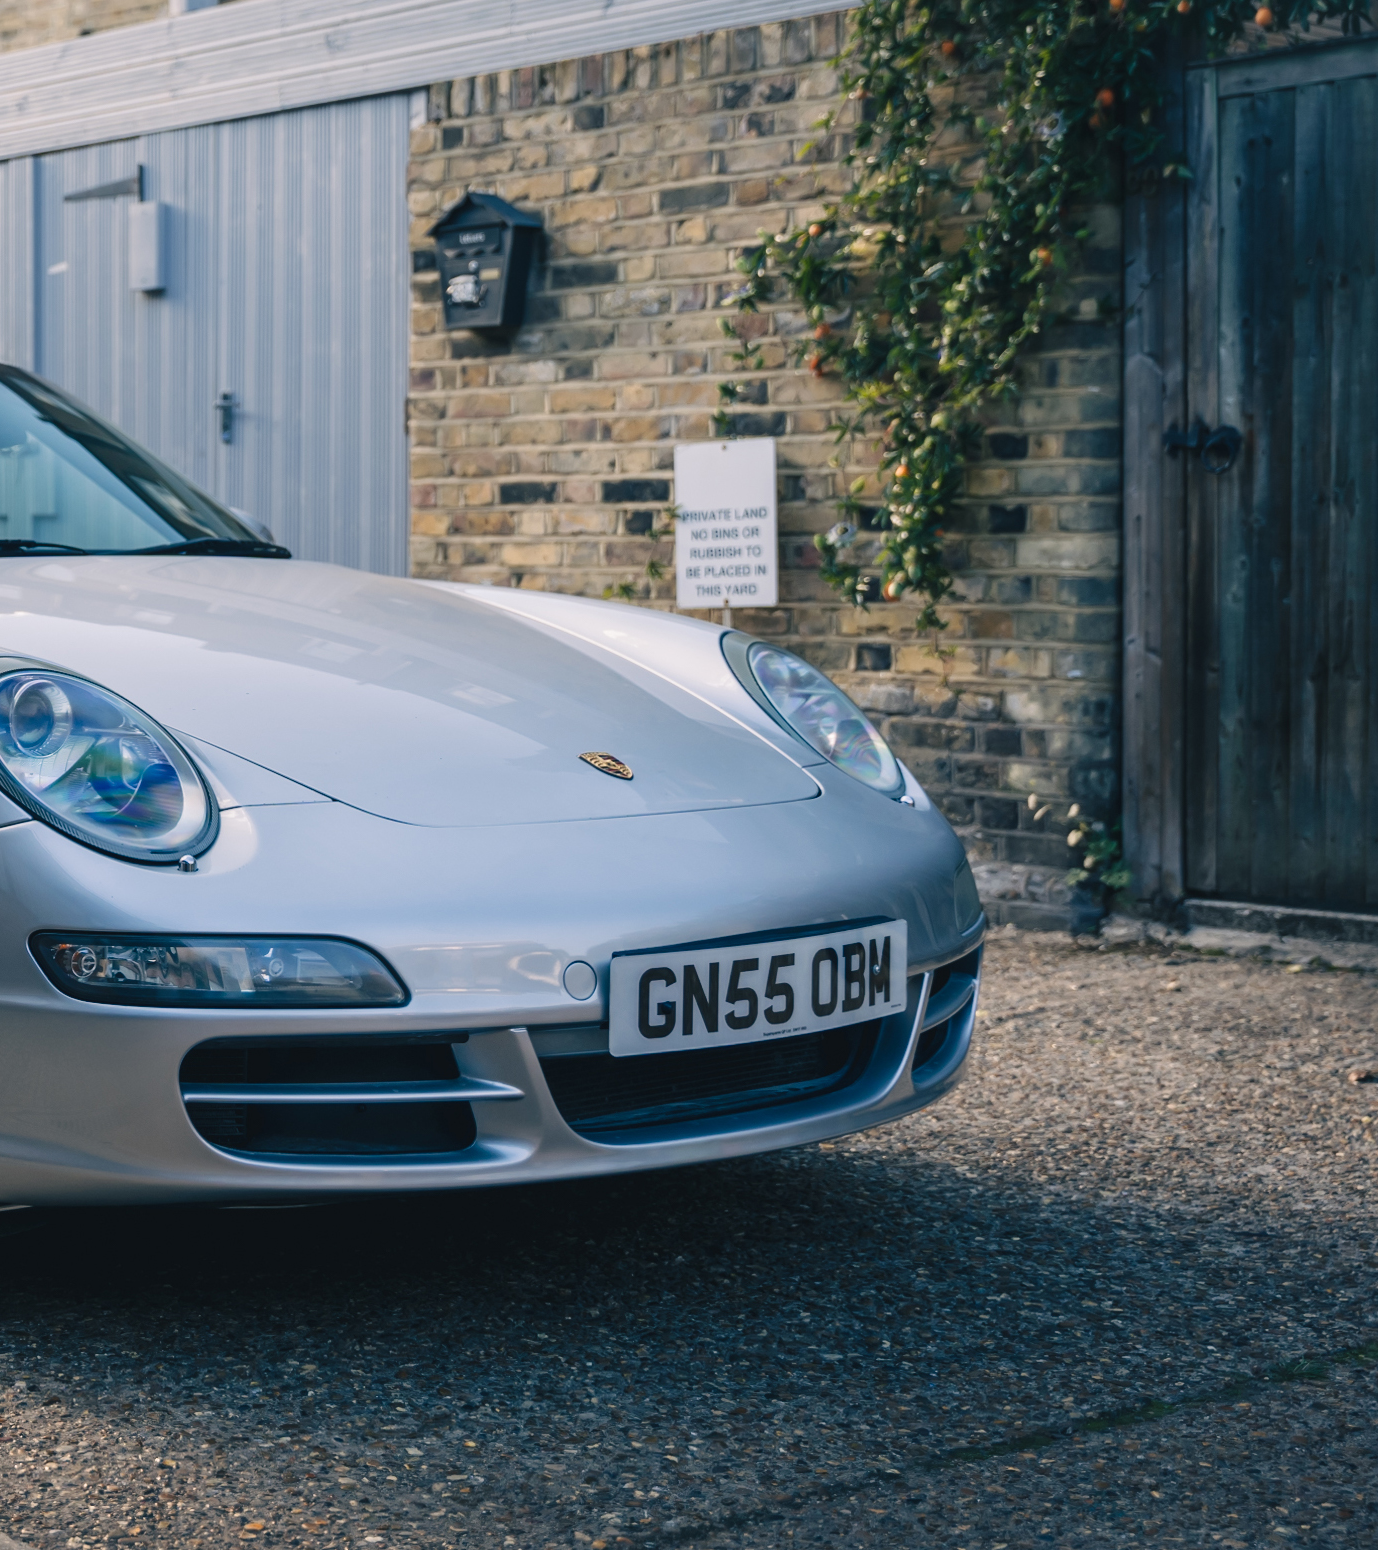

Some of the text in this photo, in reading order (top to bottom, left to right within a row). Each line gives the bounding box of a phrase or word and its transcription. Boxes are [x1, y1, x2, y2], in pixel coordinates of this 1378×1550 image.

[682, 507, 767, 522] PRIVATE LAND
[691, 526, 759, 540] NO BINS OR
[690, 545, 762, 559] RUBBISH TO
[686, 564, 767, 579] BE PLACED IN
[695, 584, 756, 597] THIS YARD
[638, 936, 891, 1039] GN55 OBM
